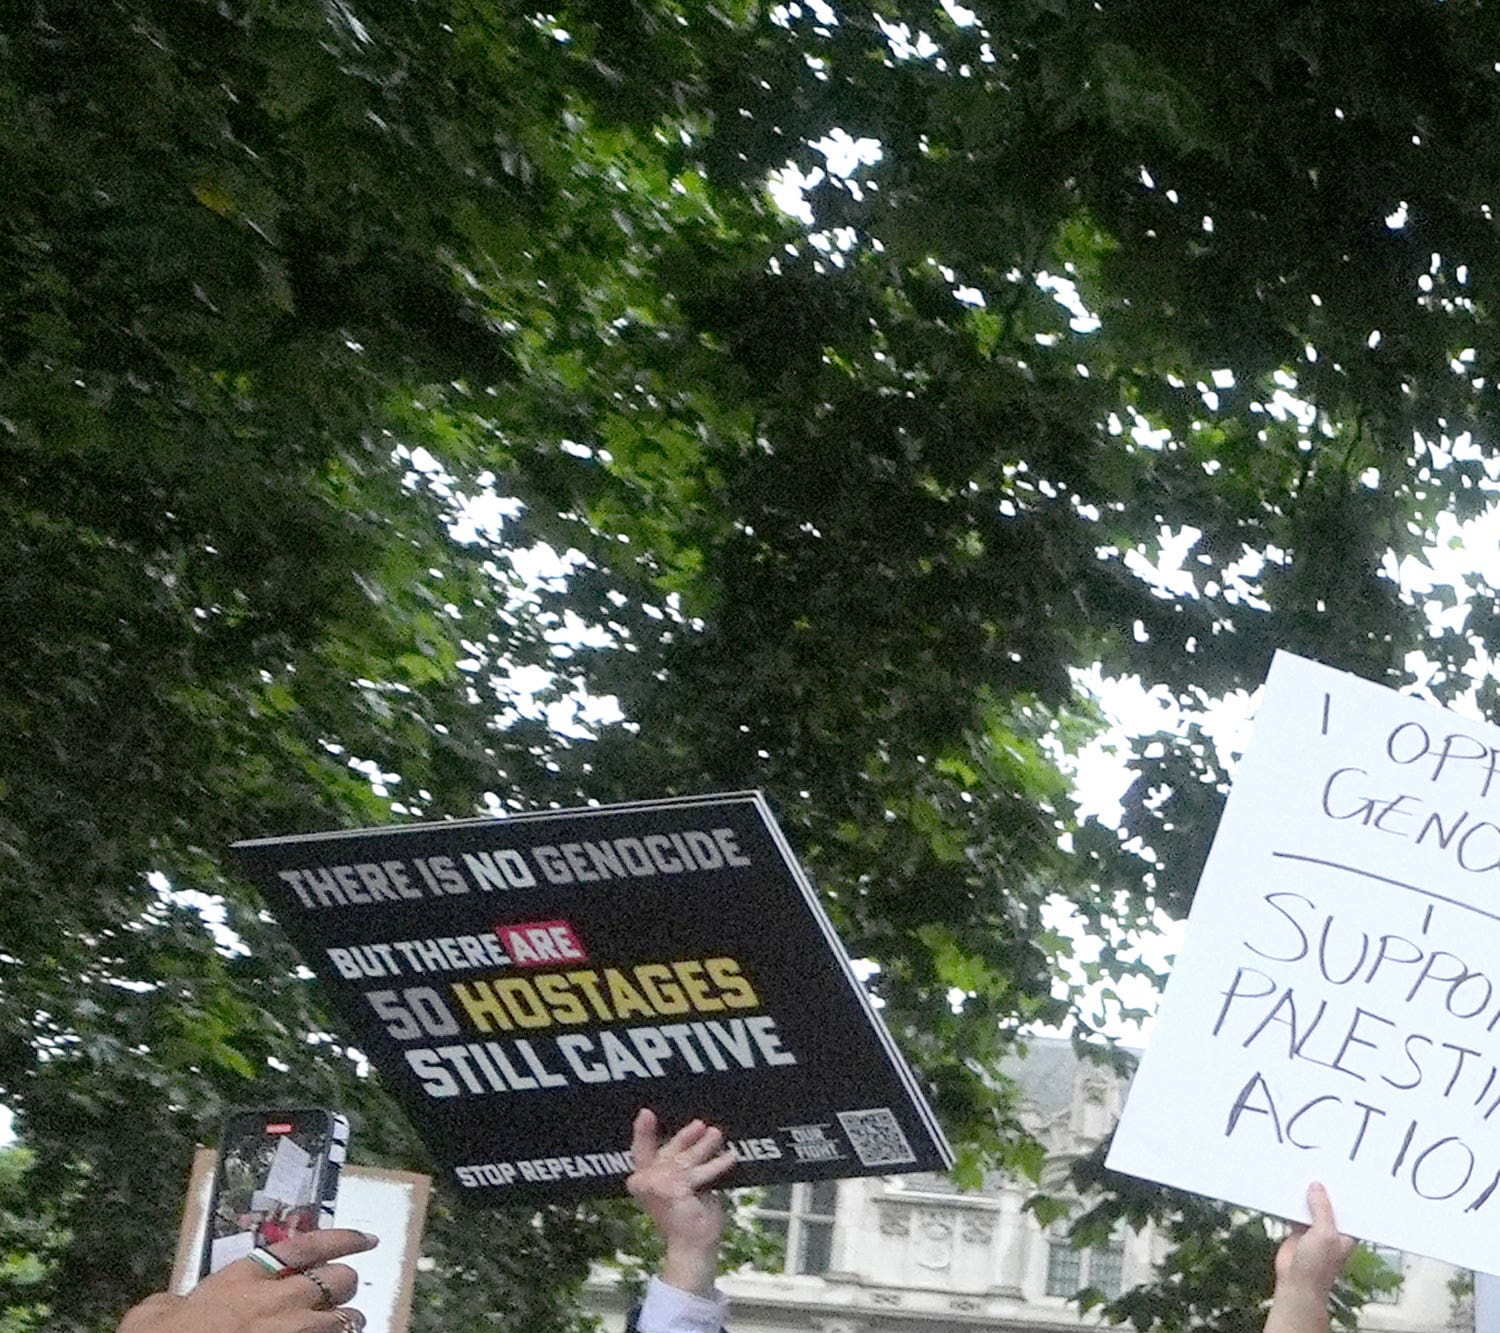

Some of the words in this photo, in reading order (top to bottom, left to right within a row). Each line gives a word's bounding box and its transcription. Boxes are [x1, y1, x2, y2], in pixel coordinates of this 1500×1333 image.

[1322, 693, 1330, 734] I
[279, 860, 423, 908] THERE
[428, 855, 470, 896] IS
[463, 848, 536, 892] NO
[534, 829, 751, 884] GENOCIDE
[1423, 904, 1434, 933] I
[327, 941, 402, 979] BUT
[401, 933, 509, 973] THERE
[508, 924, 583, 964] ARE
[367, 988, 460, 1040] 50
[453, 957, 759, 1031] HOSTAGES
[404, 1035, 566, 1098] STILL
[557, 1016, 797, 1083] CAPTIVE
[456, 1157, 524, 1188] STOP
